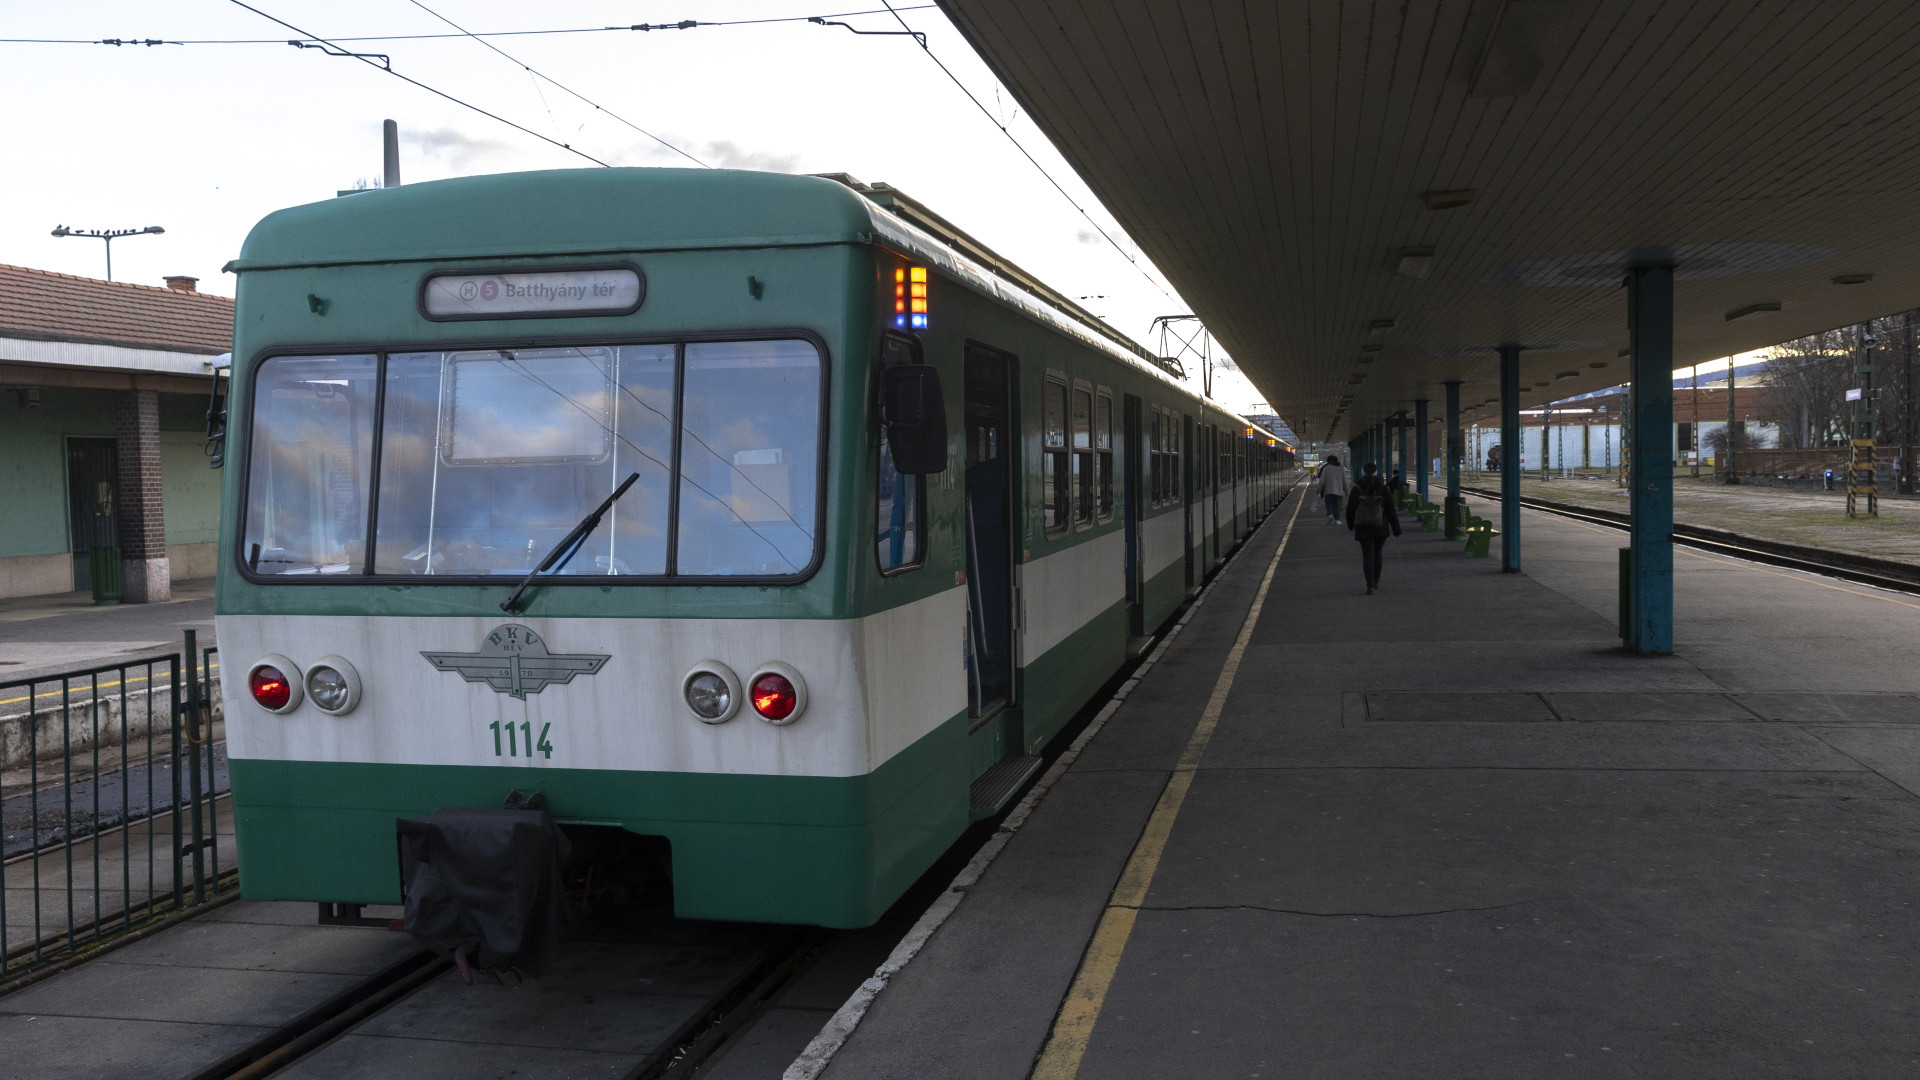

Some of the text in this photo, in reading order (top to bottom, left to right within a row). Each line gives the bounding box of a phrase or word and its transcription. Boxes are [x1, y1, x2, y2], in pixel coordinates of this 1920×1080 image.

[505, 282, 586, 302] Batthyány
[593, 281, 616, 297] tér
[489, 627, 538, 647] BKV
[489, 720, 553, 759] 1114
